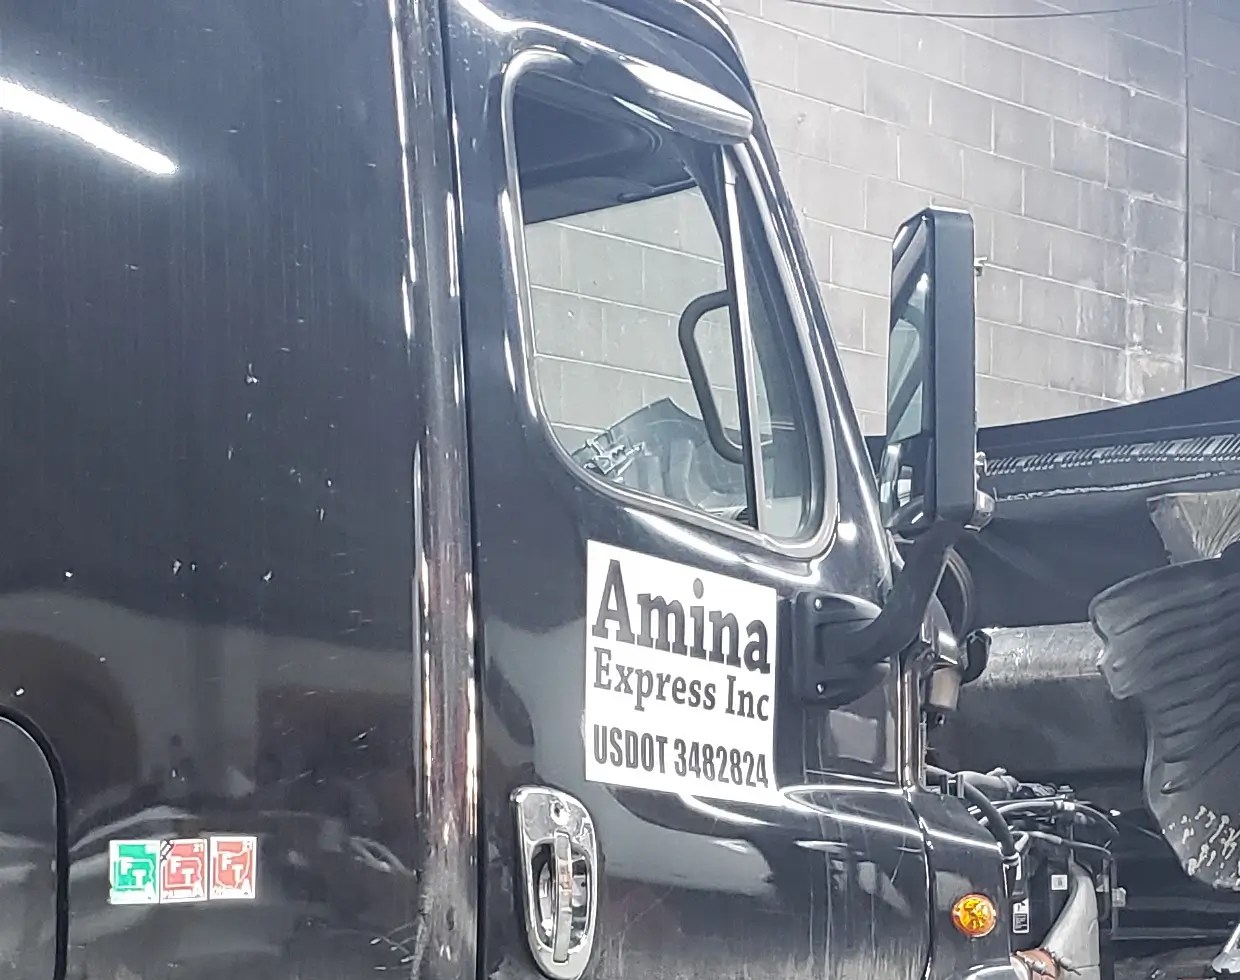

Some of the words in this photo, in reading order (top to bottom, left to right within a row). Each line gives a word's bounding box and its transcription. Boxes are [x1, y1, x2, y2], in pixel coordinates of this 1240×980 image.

[592, 559, 770, 674] Amina
[594, 646, 716, 711] Express
[725, 674, 769, 721] Inc
[594, 724, 668, 774] USDOT
[674, 738, 768, 788] 3482824
